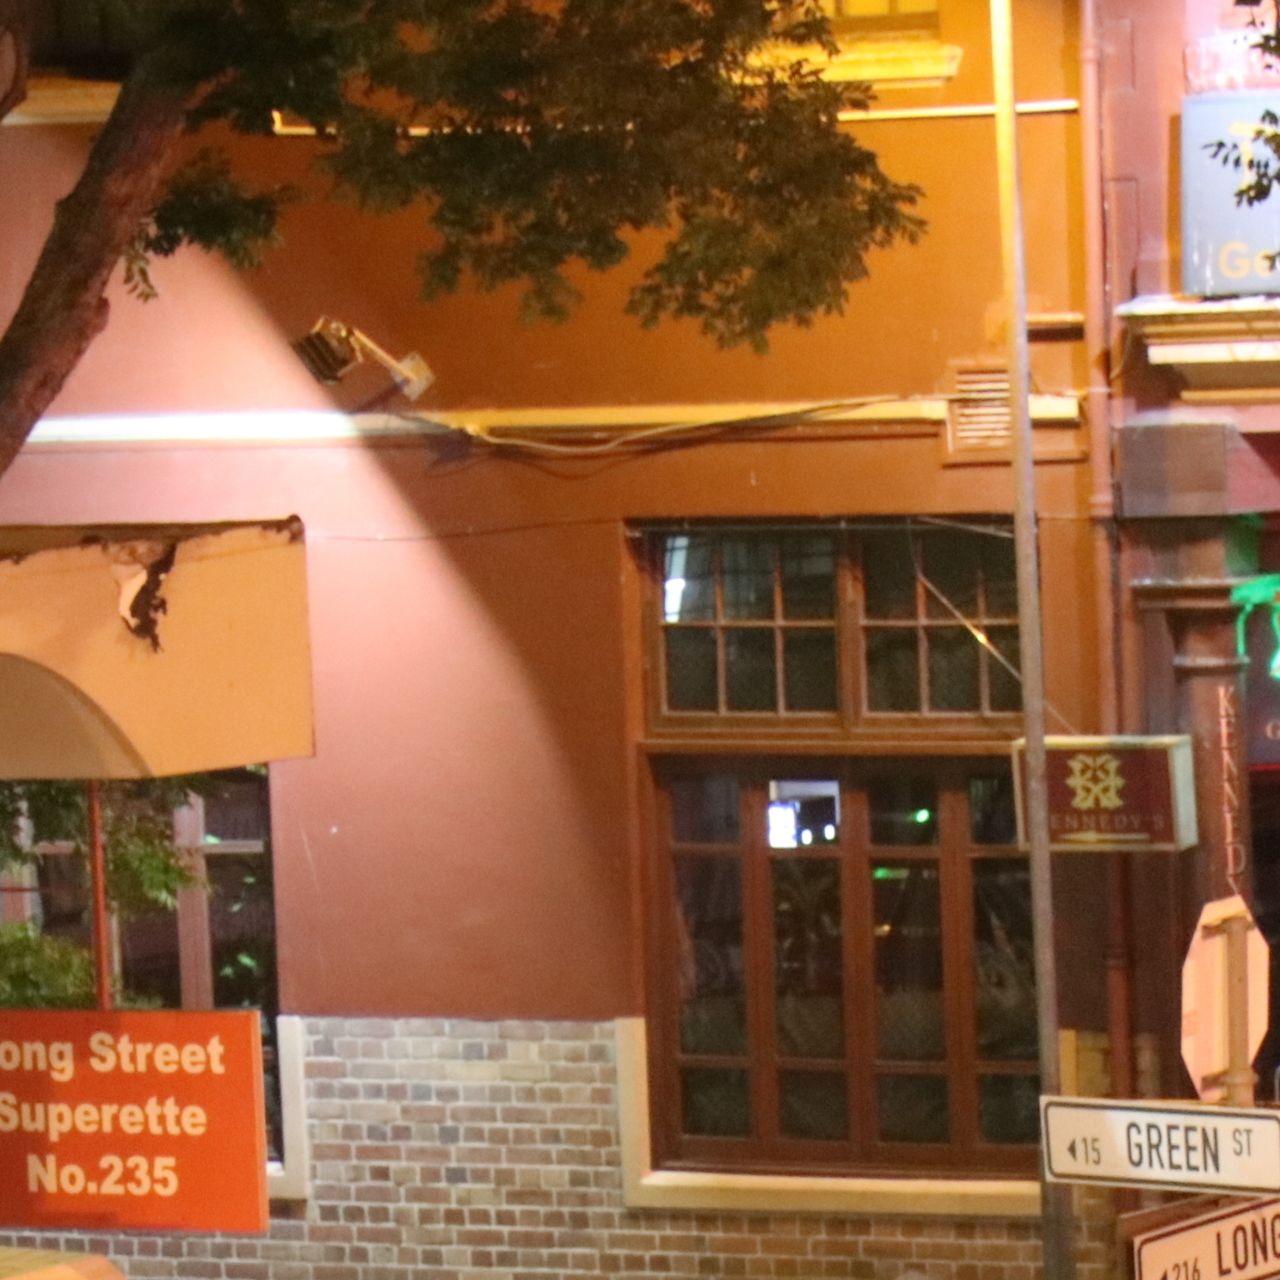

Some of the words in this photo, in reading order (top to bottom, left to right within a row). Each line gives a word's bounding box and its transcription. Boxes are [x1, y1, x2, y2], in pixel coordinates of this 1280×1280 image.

[89, 1031, 226, 1075] Street
[1081, 1136, 1102, 1166] 15
[1125, 1121, 1221, 1174] GREEN
[1232, 1127, 1254, 1157] ST
[27, 1153, 179, 1197] No.235
